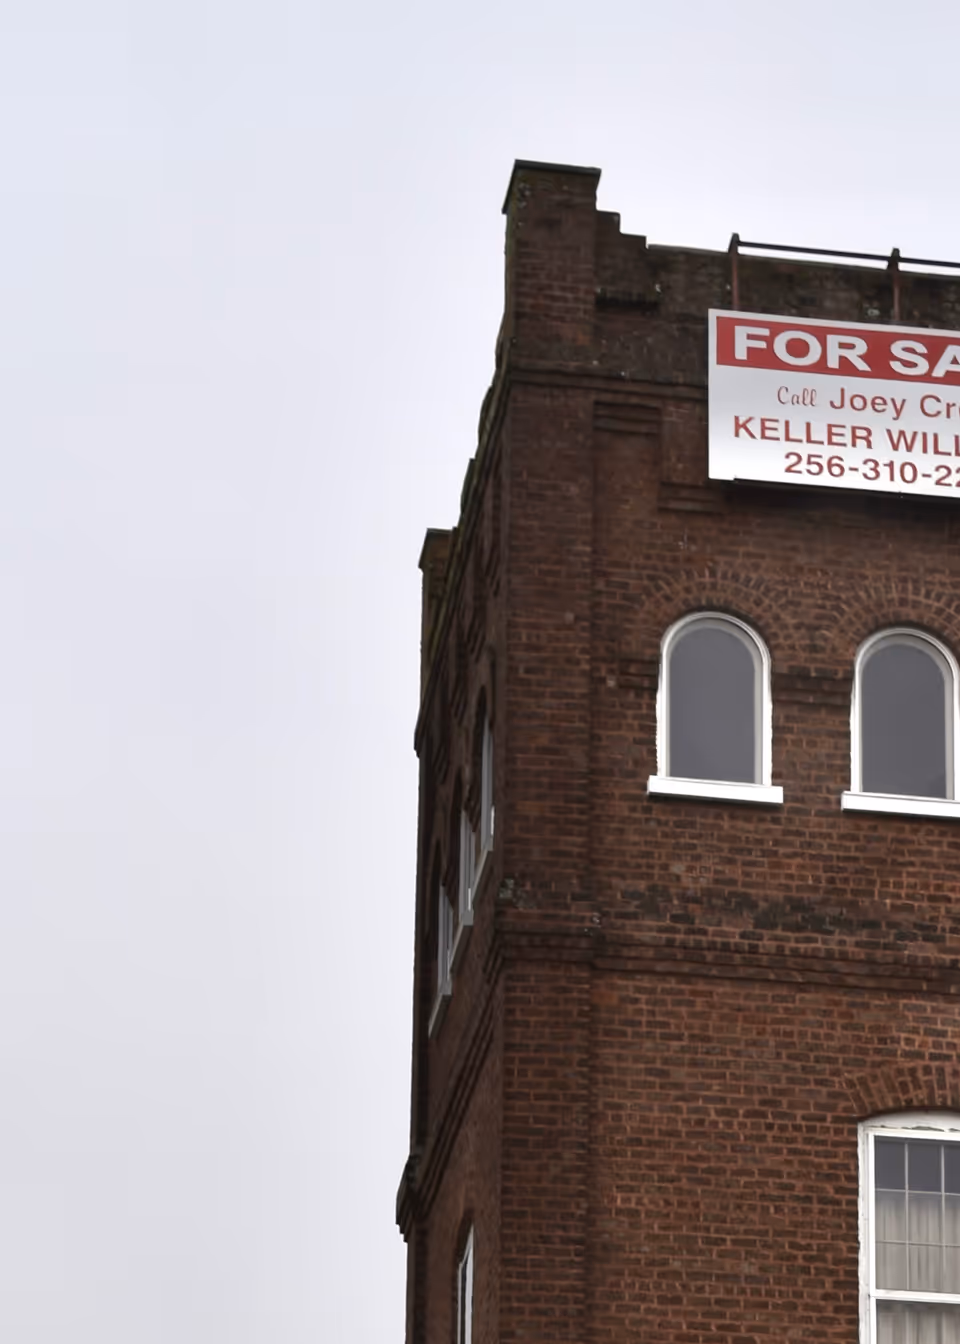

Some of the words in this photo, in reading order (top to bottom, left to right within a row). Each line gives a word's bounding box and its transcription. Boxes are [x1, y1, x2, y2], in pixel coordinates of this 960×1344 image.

[733, 325, 872, 372] FOR
[777, 385, 817, 408] Call
[829, 387, 907, 420] Joey
[733, 416, 873, 450] KELLER
